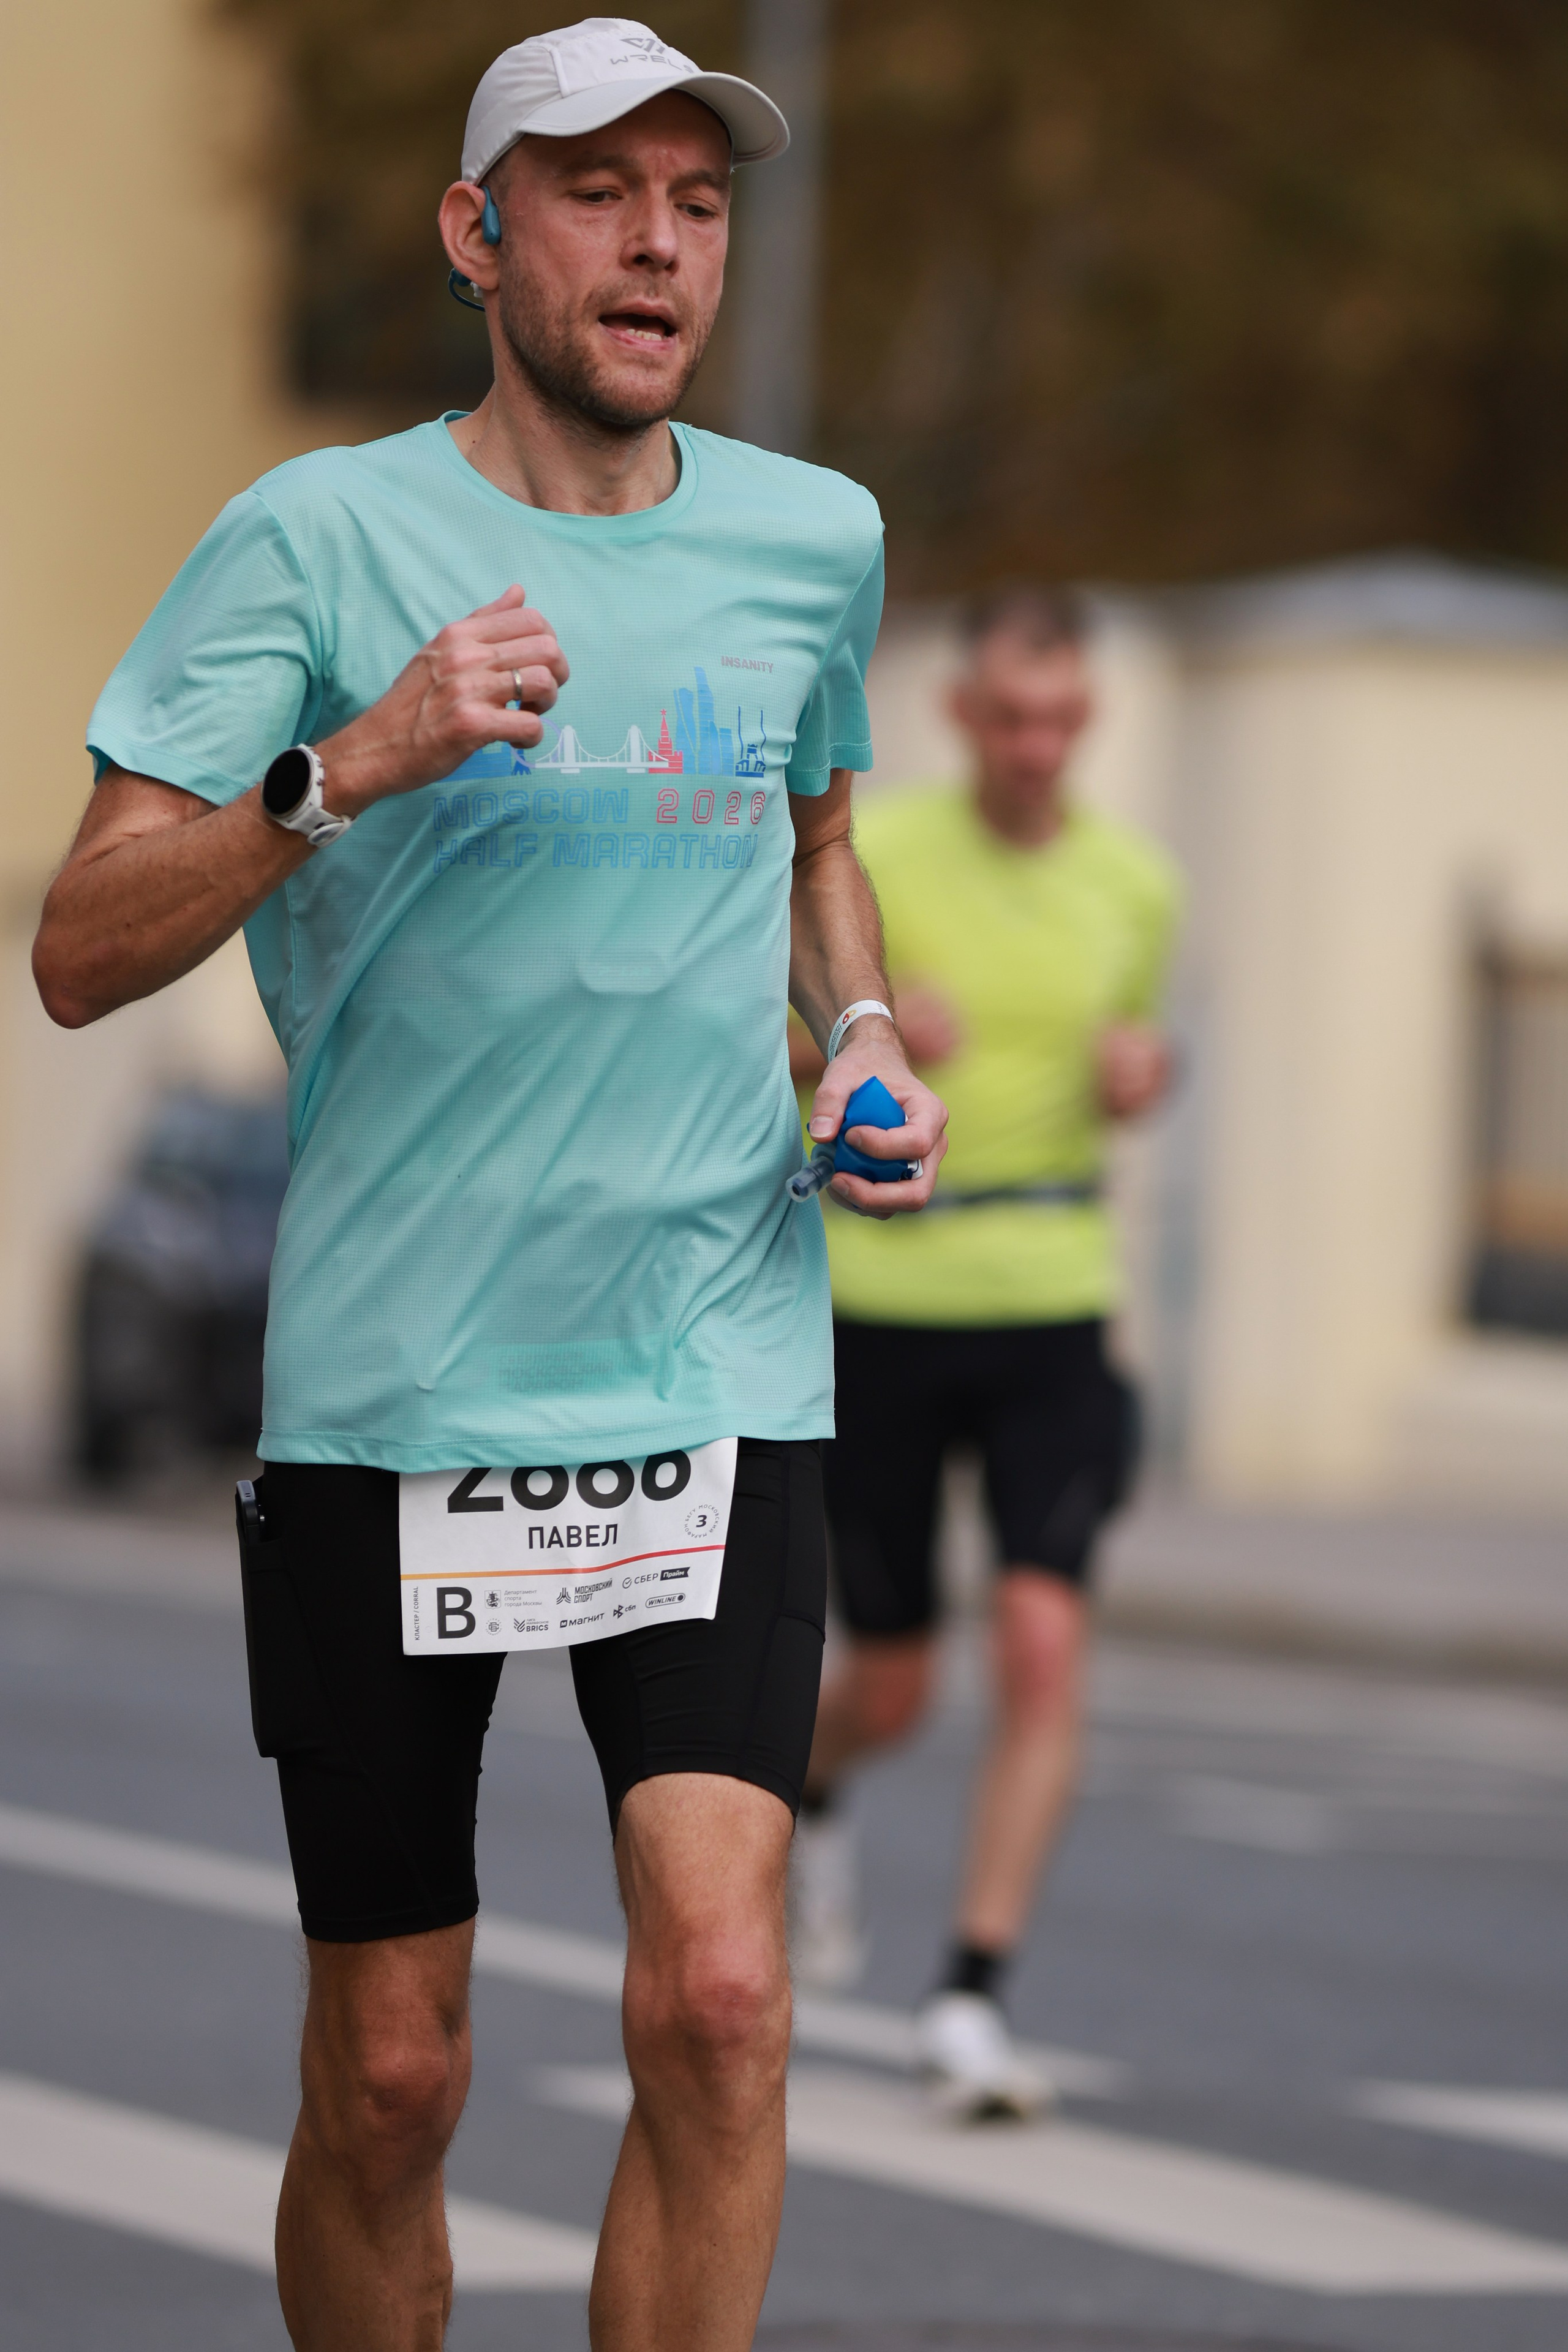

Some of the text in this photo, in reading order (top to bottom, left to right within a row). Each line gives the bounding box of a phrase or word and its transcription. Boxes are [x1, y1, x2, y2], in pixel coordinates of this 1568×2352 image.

[721, 655, 774, 673] INSANITY
[433, 788, 766, 831] MOSCOW 2026
[434, 832, 758, 873] HALF MARATHON
[695, 1514, 707, 1528] 3
[527, 1523, 619, 1550] ПАВЕЛ
[634, 1570, 685, 1584] СБЕР Прайм
[575, 1578, 612, 1595] МОСКОВСКИЙ
[574, 1593, 593, 1604] СПОРТ
[648, 1596, 676, 1606] WINLINE
